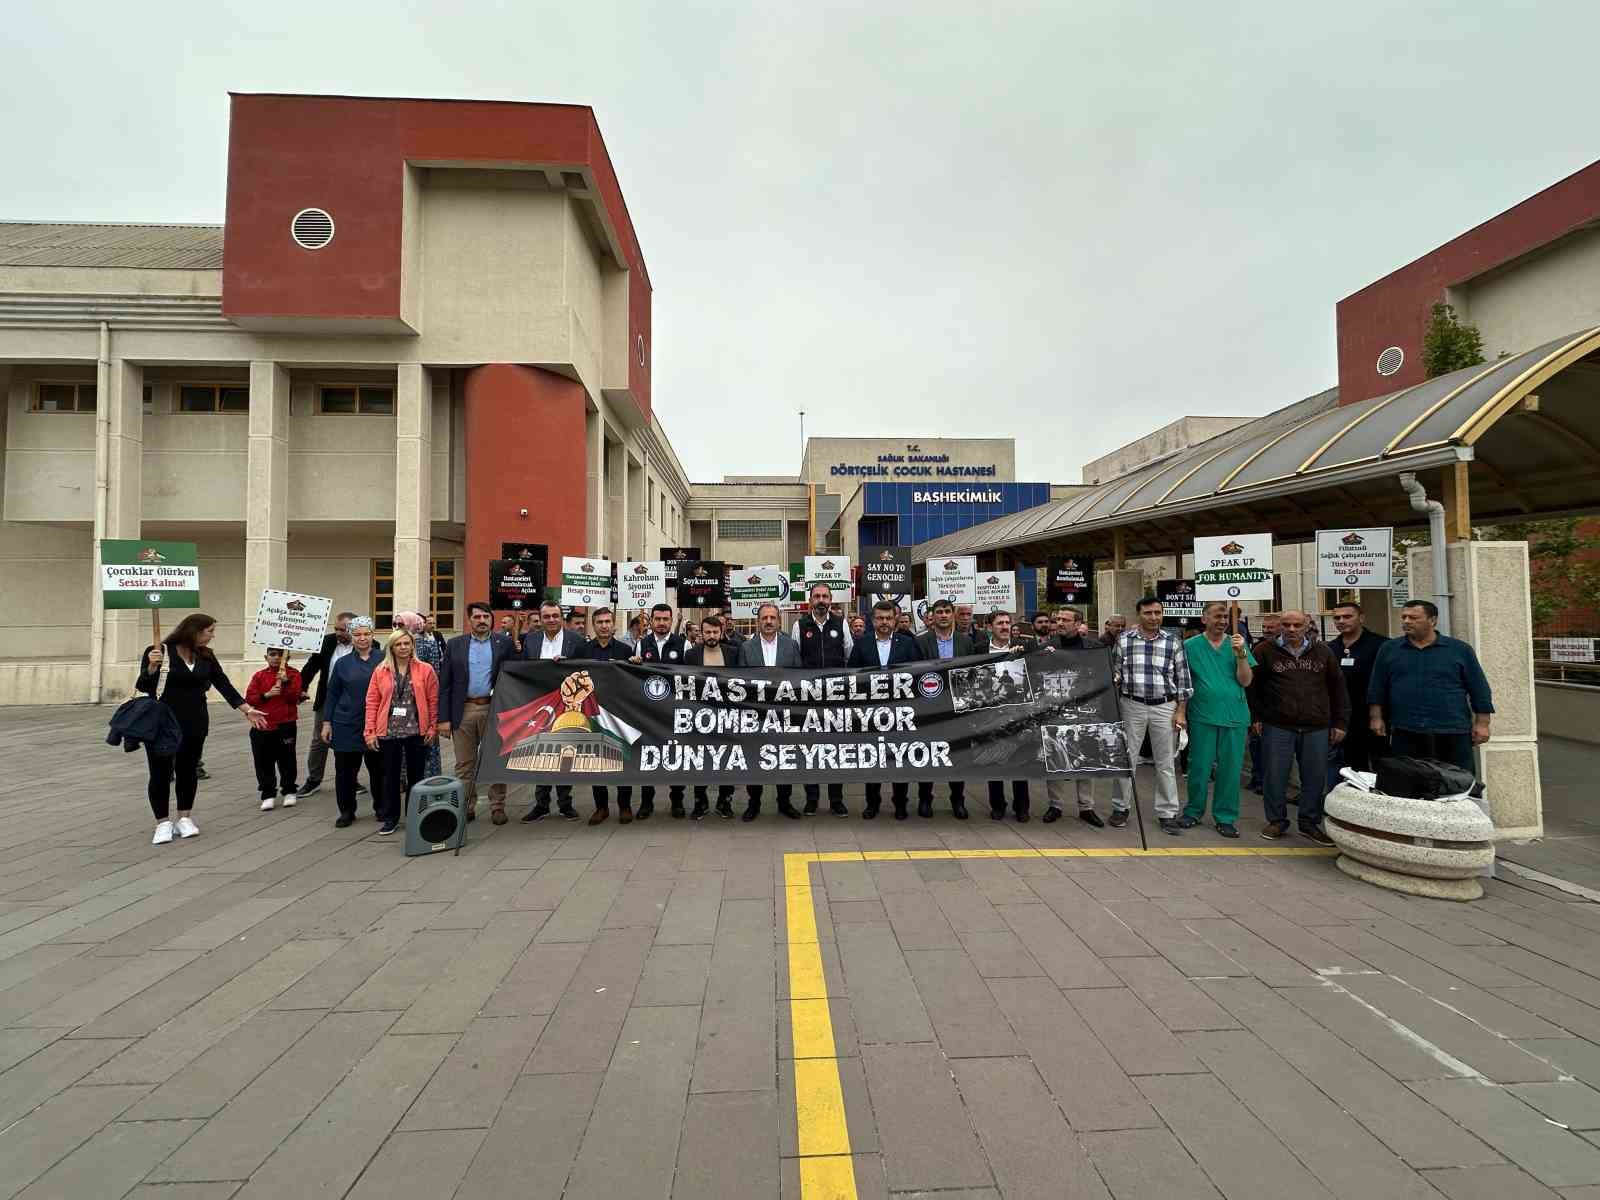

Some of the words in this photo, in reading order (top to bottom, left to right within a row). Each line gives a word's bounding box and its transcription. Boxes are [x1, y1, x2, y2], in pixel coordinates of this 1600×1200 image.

[907, 445, 921, 453] T.C.
[830, 464, 888, 478] DÖRTÇELİK
[894, 466, 932, 479] ÇOCUK
[936, 464, 996, 477] HASTANESİ
[913, 488, 1002, 506] BAŞHEKİMLİK
[867, 563, 881, 572] SAY
[883, 563, 894, 572] NO
[896, 563, 906, 572] TO
[1210, 559, 1240, 567] SPEAK
[1243, 558, 1255, 566] UP
[107, 566, 154, 578] Çocuklar
[867, 573, 905, 582] GENOCIDE
[1199, 573, 1217, 582] FOR
[1219, 571, 1268, 581] HUMANITY
[119, 579, 150, 588] Sessiz
[674, 673, 915, 702] HASTANELER
[674, 706, 917, 734] BOMBALANIYOR
[639, 740, 748, 771] DÜNYA
[759, 736, 953, 771] SEYREDİYOR
